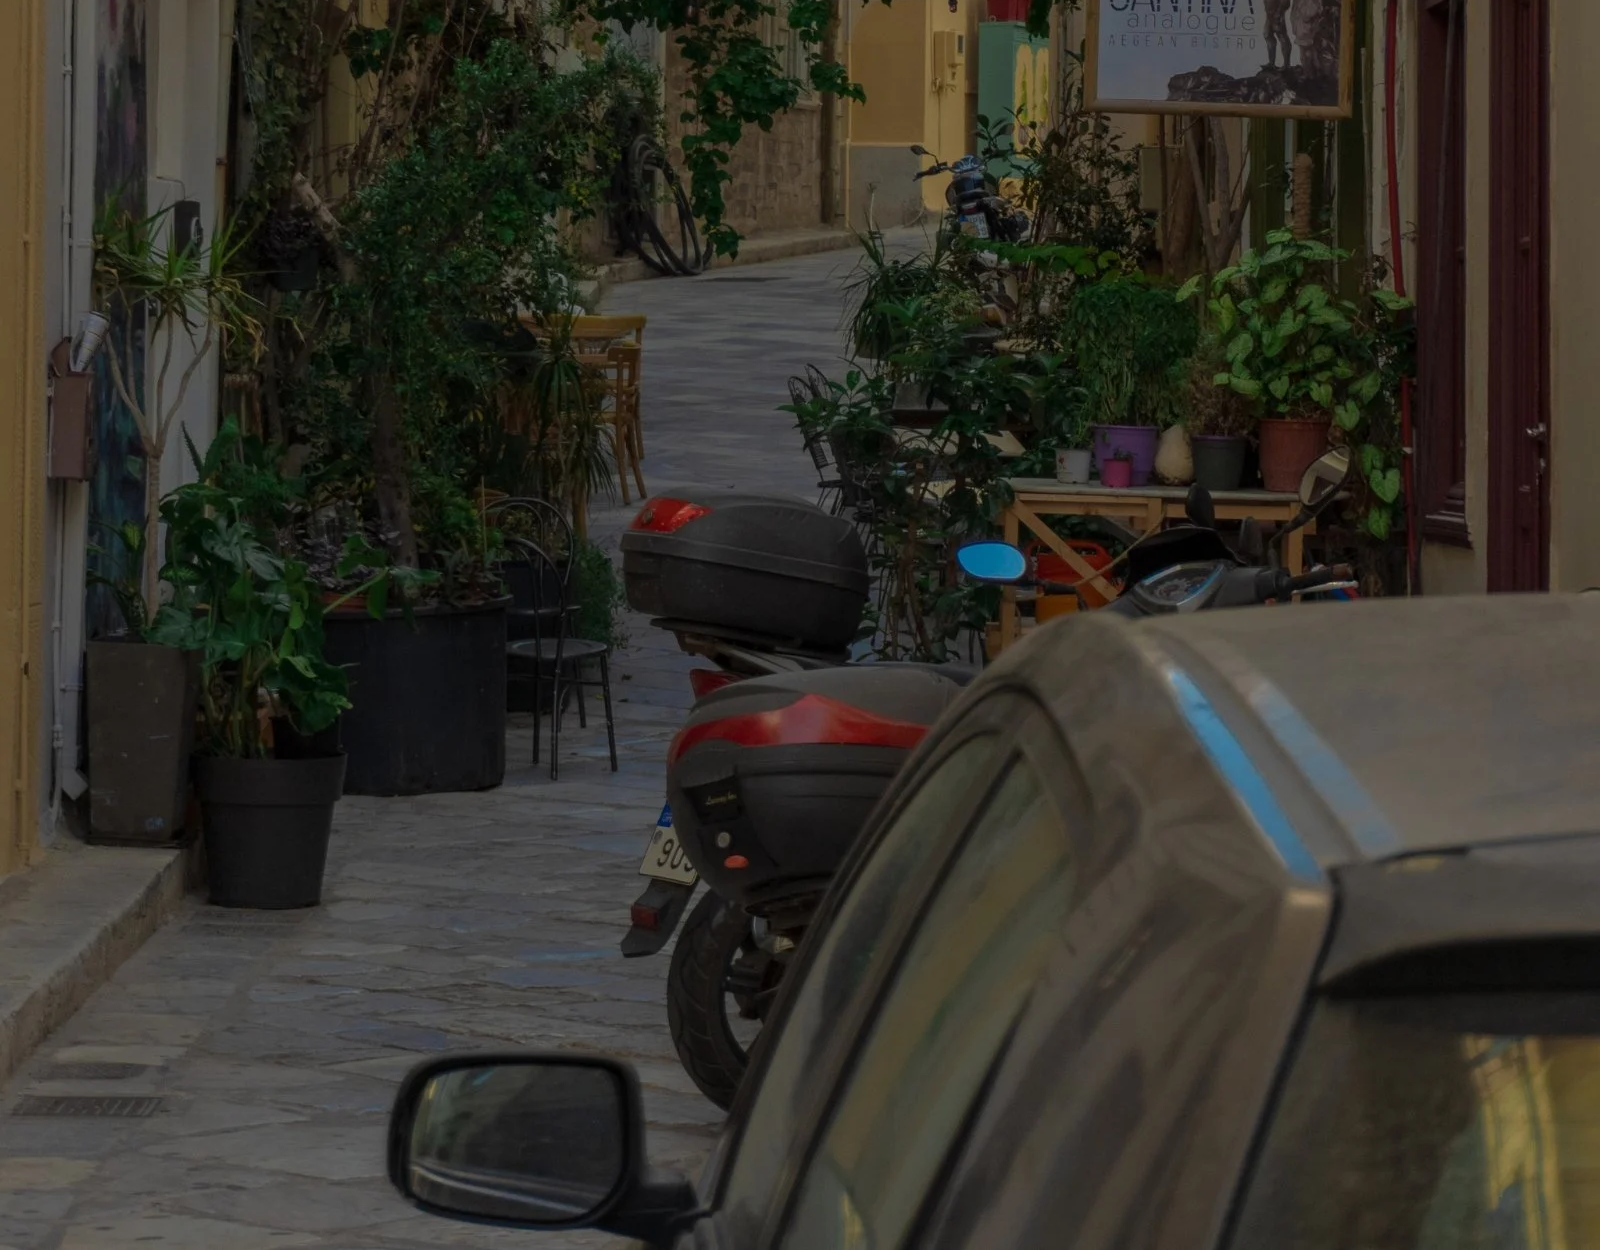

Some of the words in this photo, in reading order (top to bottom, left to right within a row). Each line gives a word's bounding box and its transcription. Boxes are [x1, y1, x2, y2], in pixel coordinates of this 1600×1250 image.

[1127, 9, 1255, 35] analogue
[1108, 34, 1177, 48] AEGEAN
[1191, 36, 1256, 50] BISTRO
